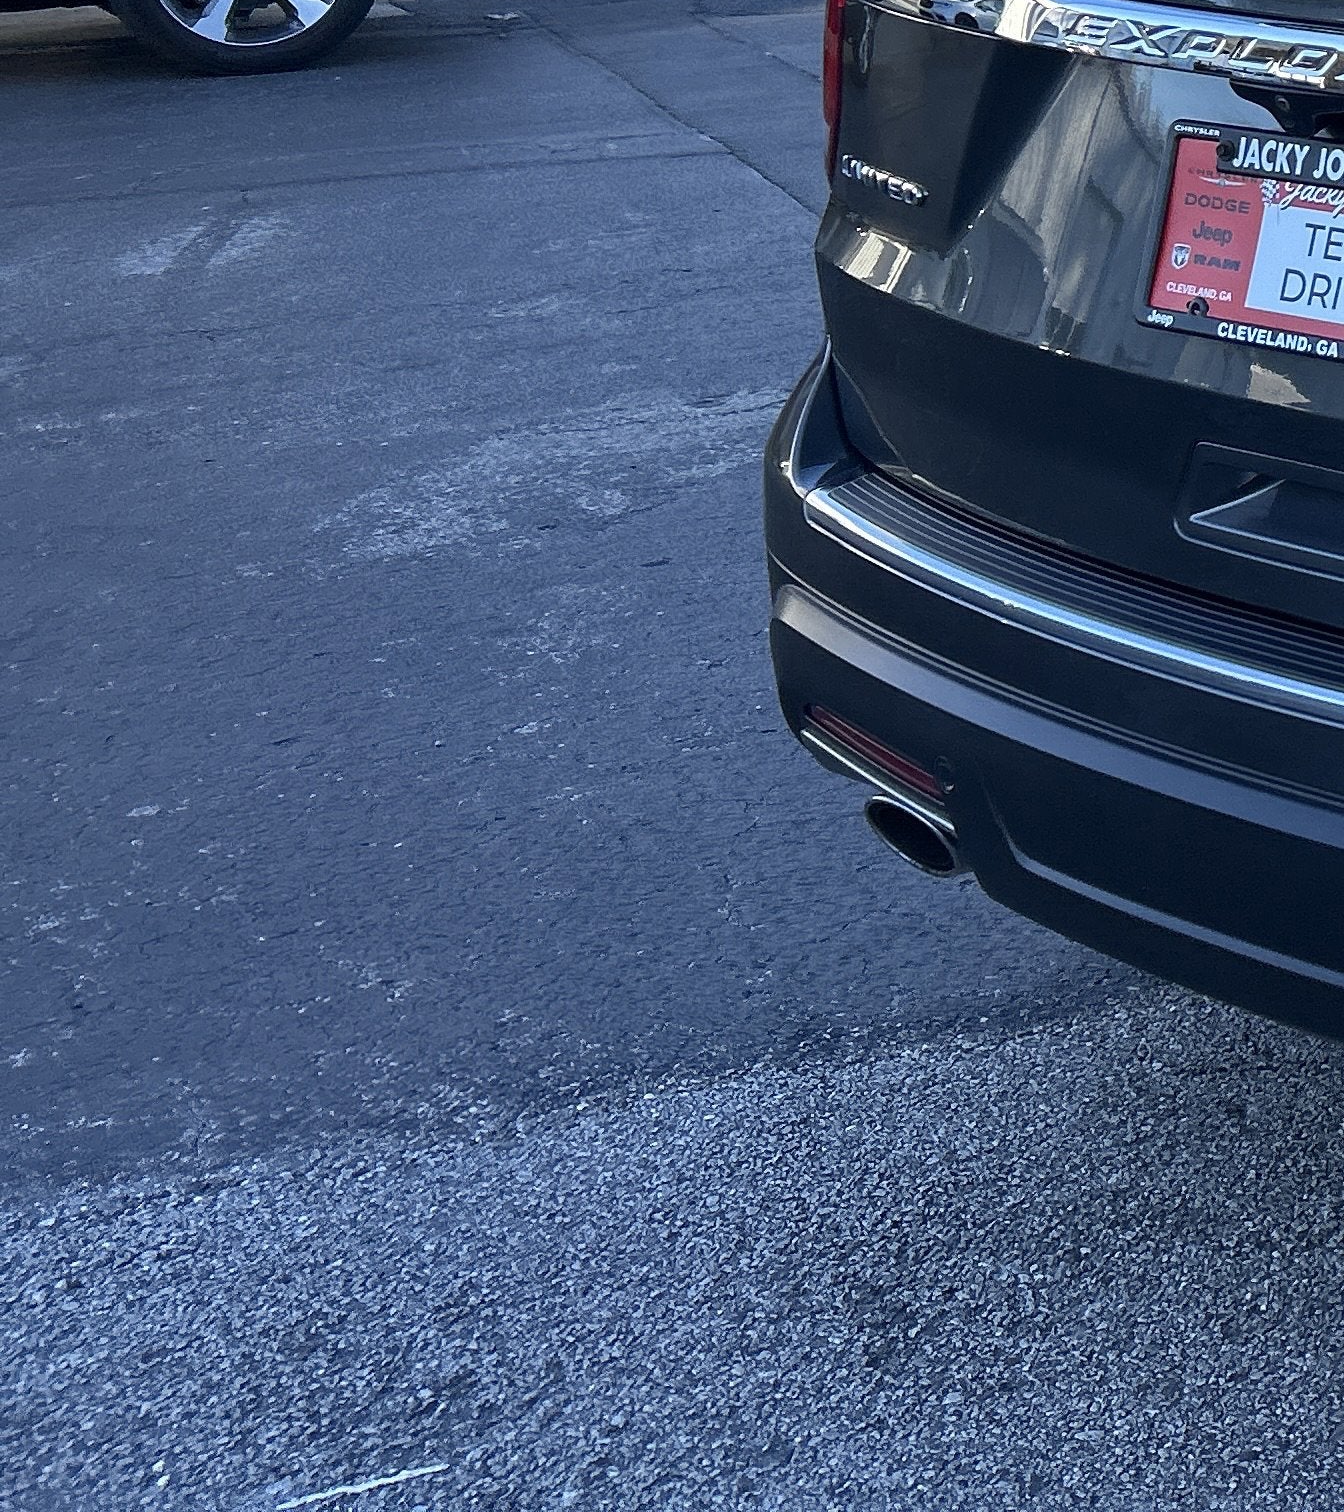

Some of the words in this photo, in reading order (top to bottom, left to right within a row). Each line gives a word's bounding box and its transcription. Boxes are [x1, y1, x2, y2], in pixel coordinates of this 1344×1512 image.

[1174, 124, 1220, 137] CHRYSLER
[1232, 136, 1310, 176] JACKY
[1184, 192, 1251, 215] DODGE
[1192, 220, 1233, 247] Jeep
[1194, 254, 1241, 271] RAM
[1166, 281, 1218, 300] CLEVELAND,
[1219, 290, 1232, 302] GA
[1147, 309, 1174, 327] Jeep
[1217, 321, 1312, 353] CLEVELAND,
[1316, 339, 1339, 358] GA
